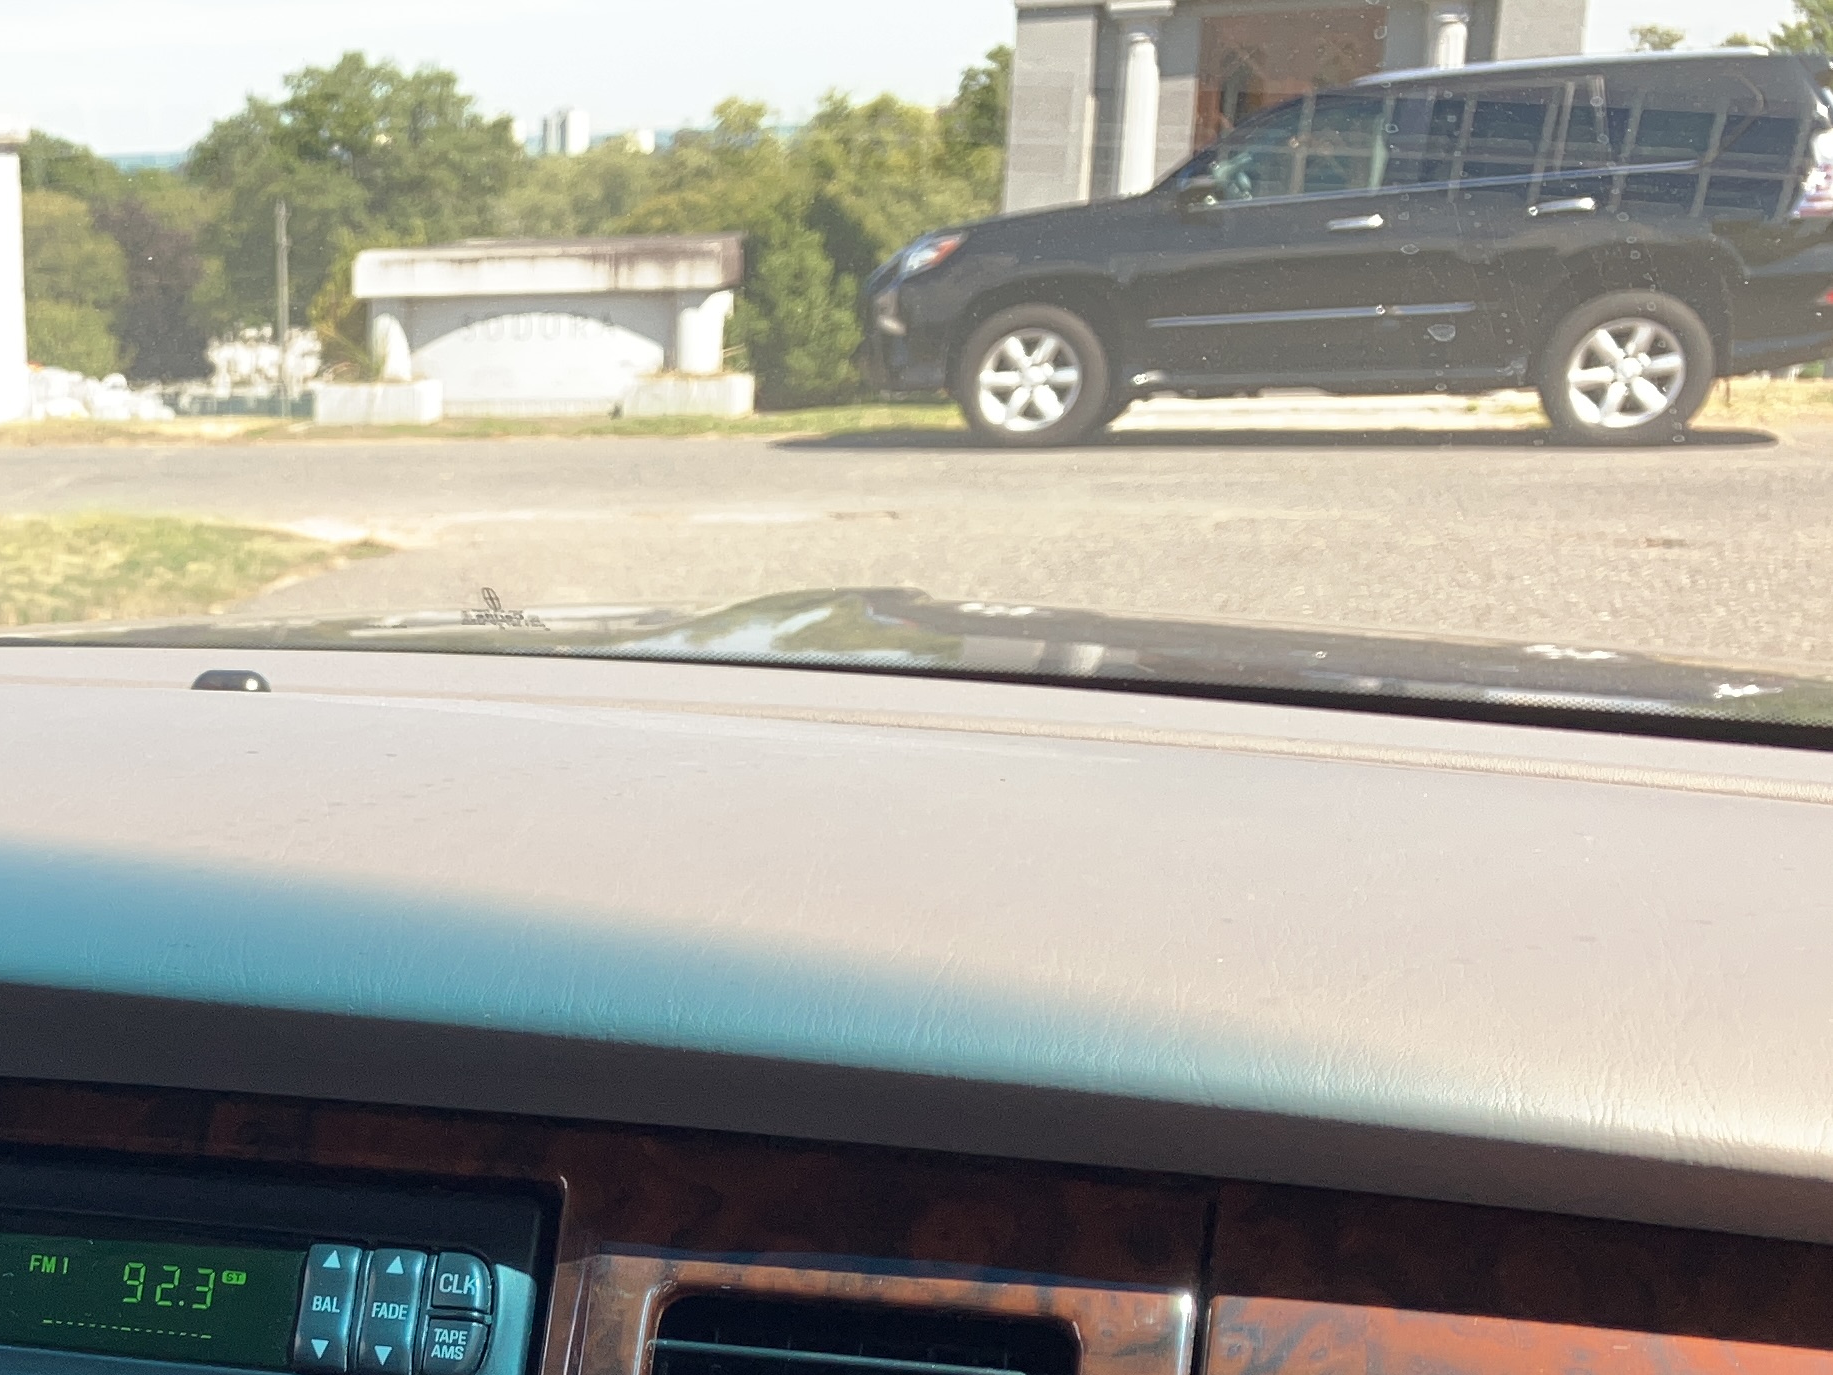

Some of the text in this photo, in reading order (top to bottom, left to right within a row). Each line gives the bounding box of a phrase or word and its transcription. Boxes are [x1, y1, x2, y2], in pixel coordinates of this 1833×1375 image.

[122, 1262, 216, 1310] 92.3
[438, 1272, 477, 1295] CLK
[312, 1295, 340, 1314] BAL
[371, 1301, 409, 1321] FADE
[433, 1328, 467, 1346] TAPE
[431, 1343, 465, 1361] AMS
